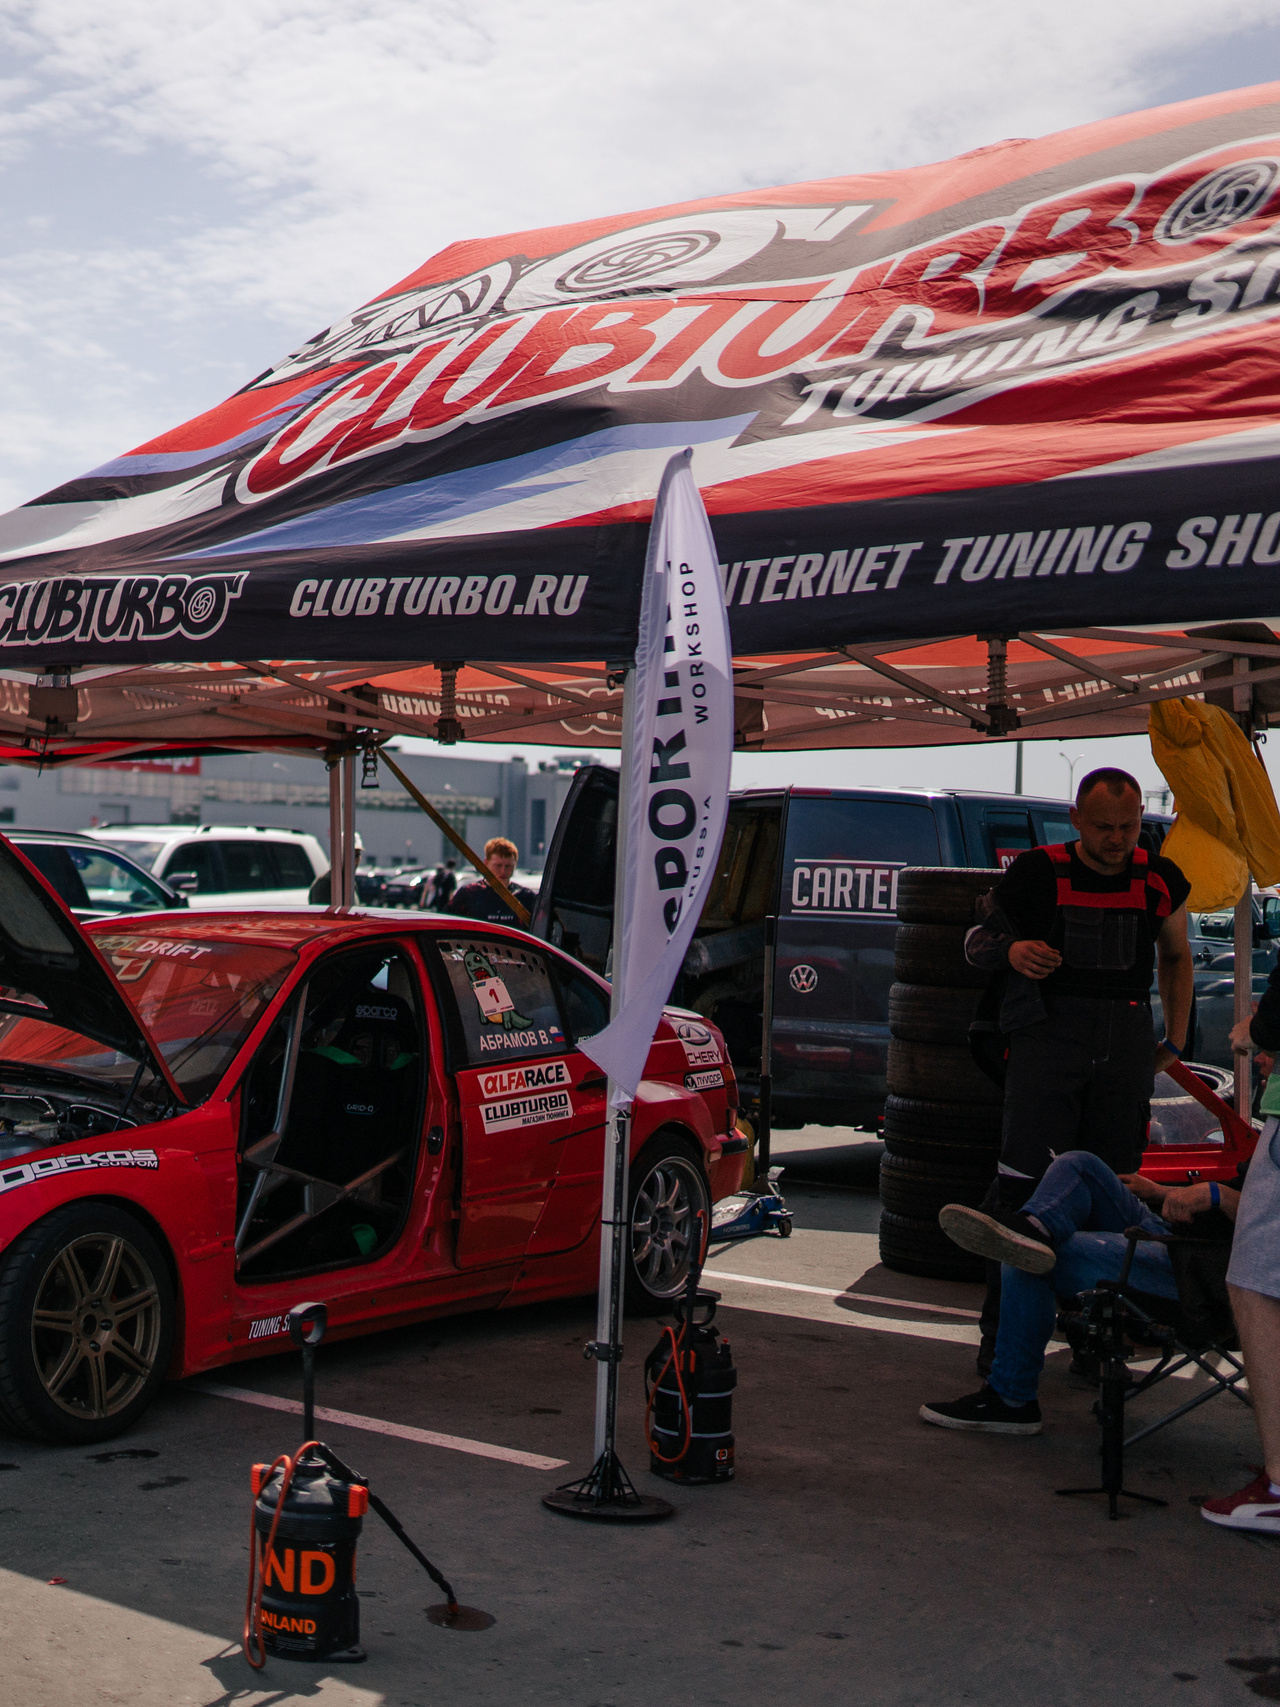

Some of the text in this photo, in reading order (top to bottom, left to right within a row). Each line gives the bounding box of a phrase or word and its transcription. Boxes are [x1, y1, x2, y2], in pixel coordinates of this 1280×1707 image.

[782, 290, 1160, 427] TUNING
[933, 521, 1153, 587] TUNING
[289, 574, 589, 618] CLUBTURBO.RU
[679, 562, 709, 725] WORKSHOP
[135, 940, 212, 960] DRIFT
[480, 1031, 538, 1051] АБРАМОВ
[686, 1050, 721, 1065] CHERY
[485, 1093, 568, 1121] CLUBTURBO
[521, 1110, 569, 1125] МАГАЗИН ТЮНИНГА
[99, 1160, 158, 1168] CUSTOM
[248, 1315, 282, 1340] TUNING
